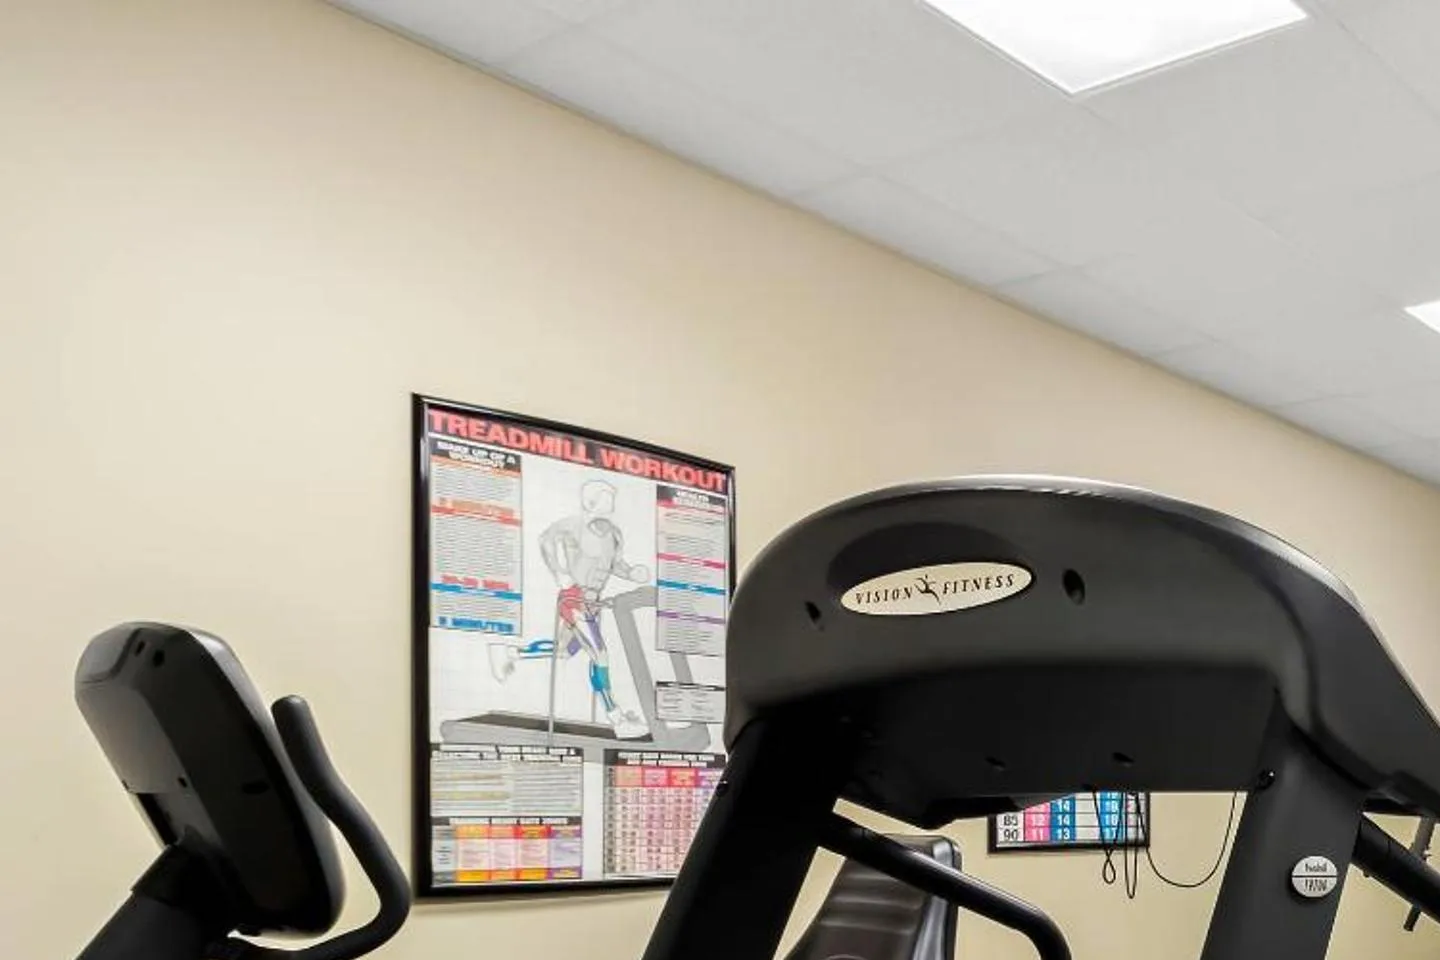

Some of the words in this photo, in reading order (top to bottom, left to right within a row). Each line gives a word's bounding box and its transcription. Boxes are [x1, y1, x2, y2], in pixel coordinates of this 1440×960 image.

[428, 408, 594, 464] TREADMILL
[600, 446, 726, 491] WORKOUT
[855, 586, 914, 605] VISION
[942, 573, 1015, 595] FITNESS
[1057, 814, 1070, 826] 14
[1003, 828, 1018, 841] 90
[1057, 828, 1070, 840] 13
